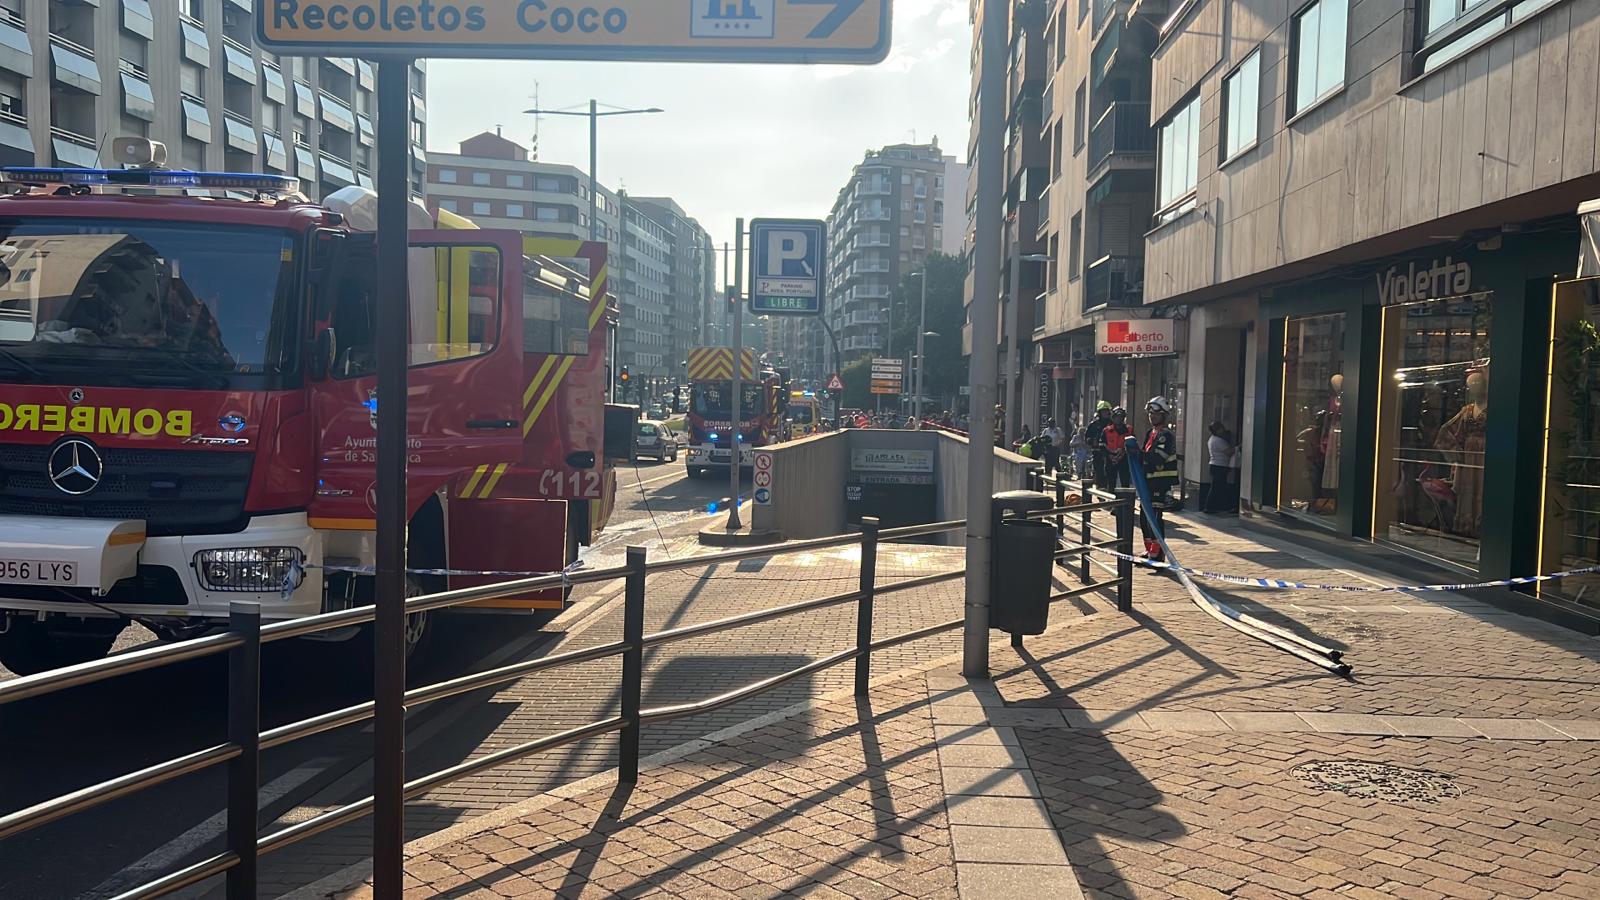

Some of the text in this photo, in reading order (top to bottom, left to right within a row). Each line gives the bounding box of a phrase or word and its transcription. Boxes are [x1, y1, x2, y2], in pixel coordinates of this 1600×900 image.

[273, 0, 627, 33] Recoletos Coco
[768, 231, 807, 275] P
[1376, 256, 1471, 306] Violetta
[771, 297, 801, 308] LIBRE
[1124, 331, 1164, 342] alberto
[1101, 345, 1134, 353] Cocina
[1145, 344, 1169, 352] Baño
[345, 450, 358, 462] de
[551, 471, 600, 497] 112
[38, 563, 72, 581] LYS
